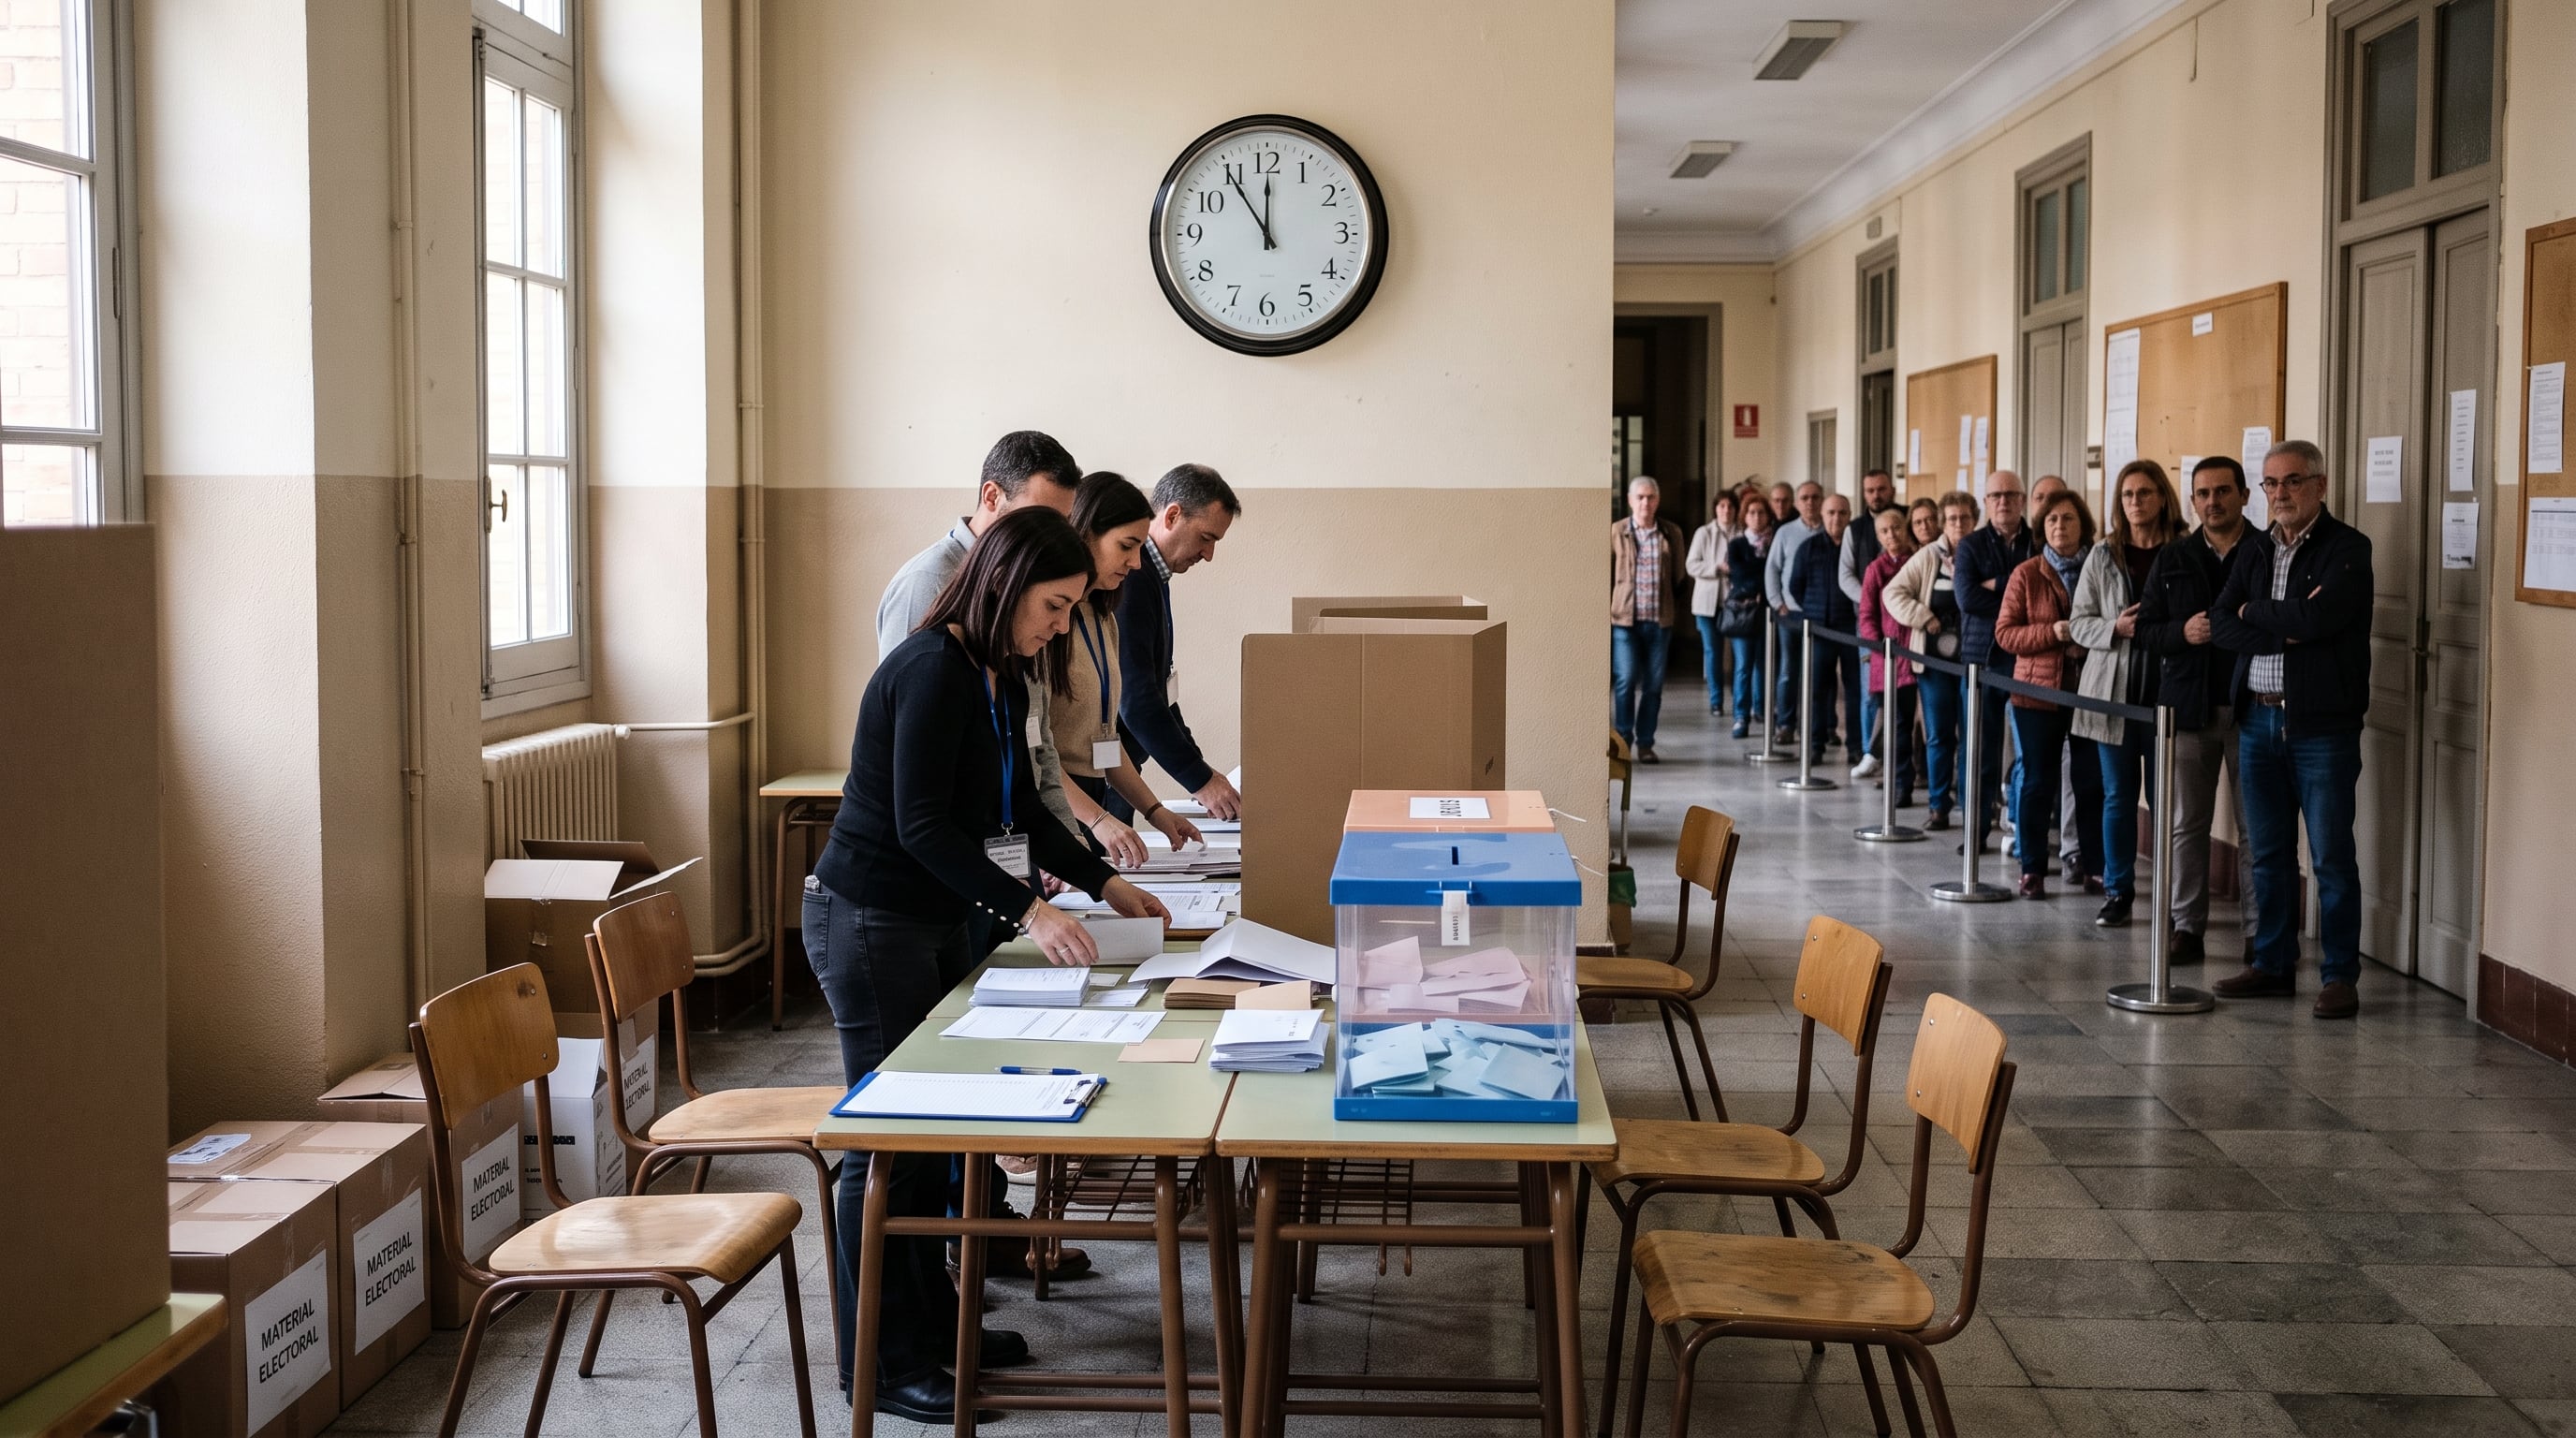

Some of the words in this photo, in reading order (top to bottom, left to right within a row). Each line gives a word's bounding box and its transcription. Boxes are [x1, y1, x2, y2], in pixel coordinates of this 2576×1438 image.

[1222, 163, 1246, 185] 11
[1252, 152, 1281, 174] 12
[1297, 161, 1309, 183] 1
[1197, 190, 1224, 213] 10
[1321, 184, 1337, 207] 2
[1187, 223, 1203, 246] 9
[1334, 222, 1349, 243] 3
[1198, 259, 1213, 281] 8
[1321, 257, 1338, 280] 4
[1226, 285, 1241, 306] 7
[1259, 292, 1275, 316] 6
[1297, 284, 1312, 306] 5
[473, 1156, 510, 1193] MATERIAL
[367, 1231, 413, 1276] MATERIAL
[365, 1256, 417, 1307] ELECTORAL
[261, 1299, 315, 1351] MATERIAL
[259, 1326, 319, 1384] ELECTORAL
